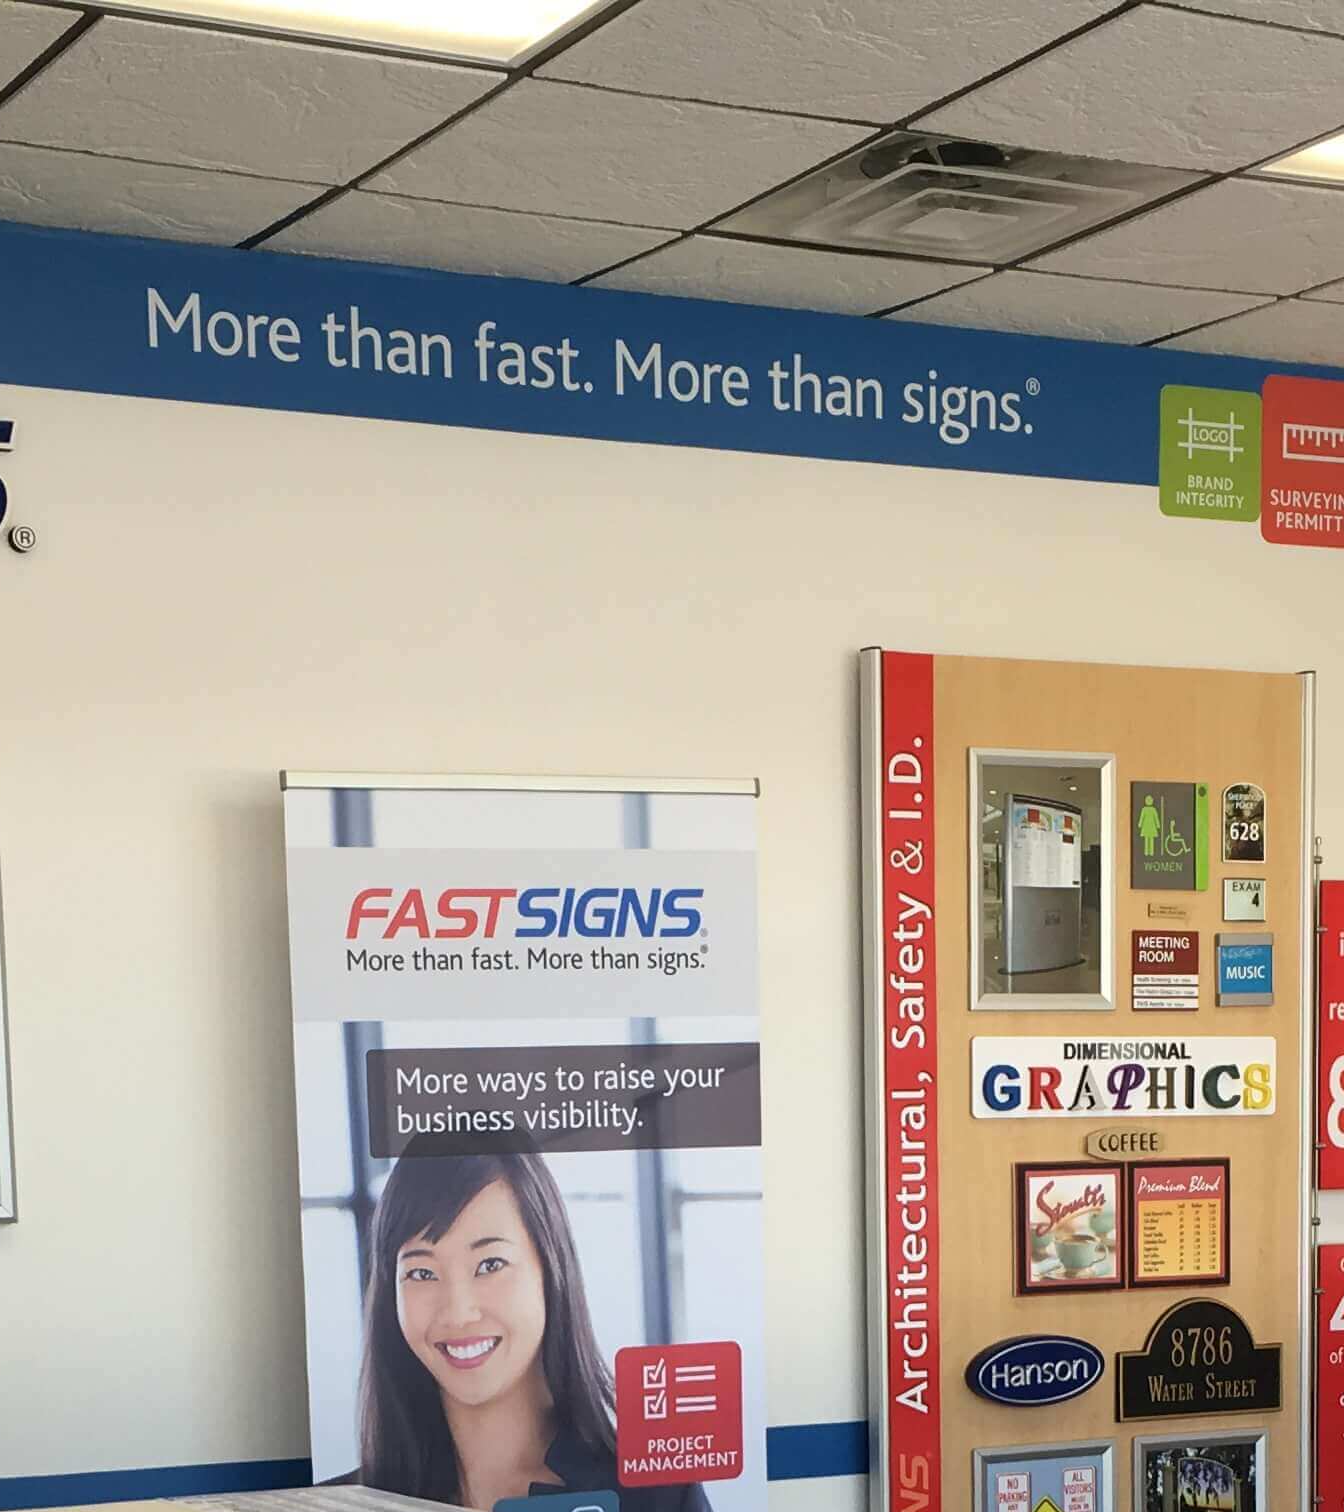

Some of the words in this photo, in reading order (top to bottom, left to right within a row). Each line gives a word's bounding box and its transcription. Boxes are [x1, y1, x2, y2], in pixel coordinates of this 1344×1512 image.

[145, 287, 300, 361] More
[322, 306, 453, 377] than
[475, 322, 594, 394] fast.
[615, 338, 750, 406] More
[768, 358, 883, 418] than
[1193, 428, 1228, 444] LOGO
[1188, 476, 1233, 490] BRAND
[1176, 491, 1244, 508] INTEGRITY
[889, 736, 923, 820] I.D.
[1230, 823, 1259, 841] 628
[892, 840, 923, 873] &
[1144, 861, 1183, 872] WOMEN
[1232, 882, 1260, 891] EXAM
[1252, 892, 1259, 907] 4
[1138, 937, 1190, 949] MEETING
[346, 949, 404, 971] More
[413, 948, 462, 970] than
[472, 947, 519, 970] fast.
[527, 948, 583, 970] More
[590, 946, 638, 969] than
[1138, 951, 1174, 962] ROOM
[891, 892, 934, 1048] Safety
[1226, 966, 1265, 979] MUSIC
[1064, 1043, 1191, 1060] DIMENSIONAL
[396, 1067, 467, 1095] More
[477, 1071, 546, 1100] ways
[556, 1067, 584, 1091] to
[593, 1063, 655, 1090] raise
[664, 1065, 724, 1099] your
[982, 1064, 1273, 1111] GRAPHICS
[397, 1105, 514, 1133] business
[524, 1100, 644, 1134] visibility.
[1098, 1133, 1158, 1152] COFFEE
[1137, 1176, 1186, 1194] Premium
[1189, 1176, 1221, 1192] Blend
[892, 1070, 934, 1413] Architectural,
[1171, 1327, 1232, 1367] 8786
[1329, 1348, 1343, 1365] of
[991, 1358, 1088, 1389] Hanson
[647, 1434, 714, 1454] PROJECT
[623, 1450, 738, 1474] MANAGEMENT
[1007, 1477, 1019, 1489] NO
[1072, 1472, 1083, 1481] ALL
